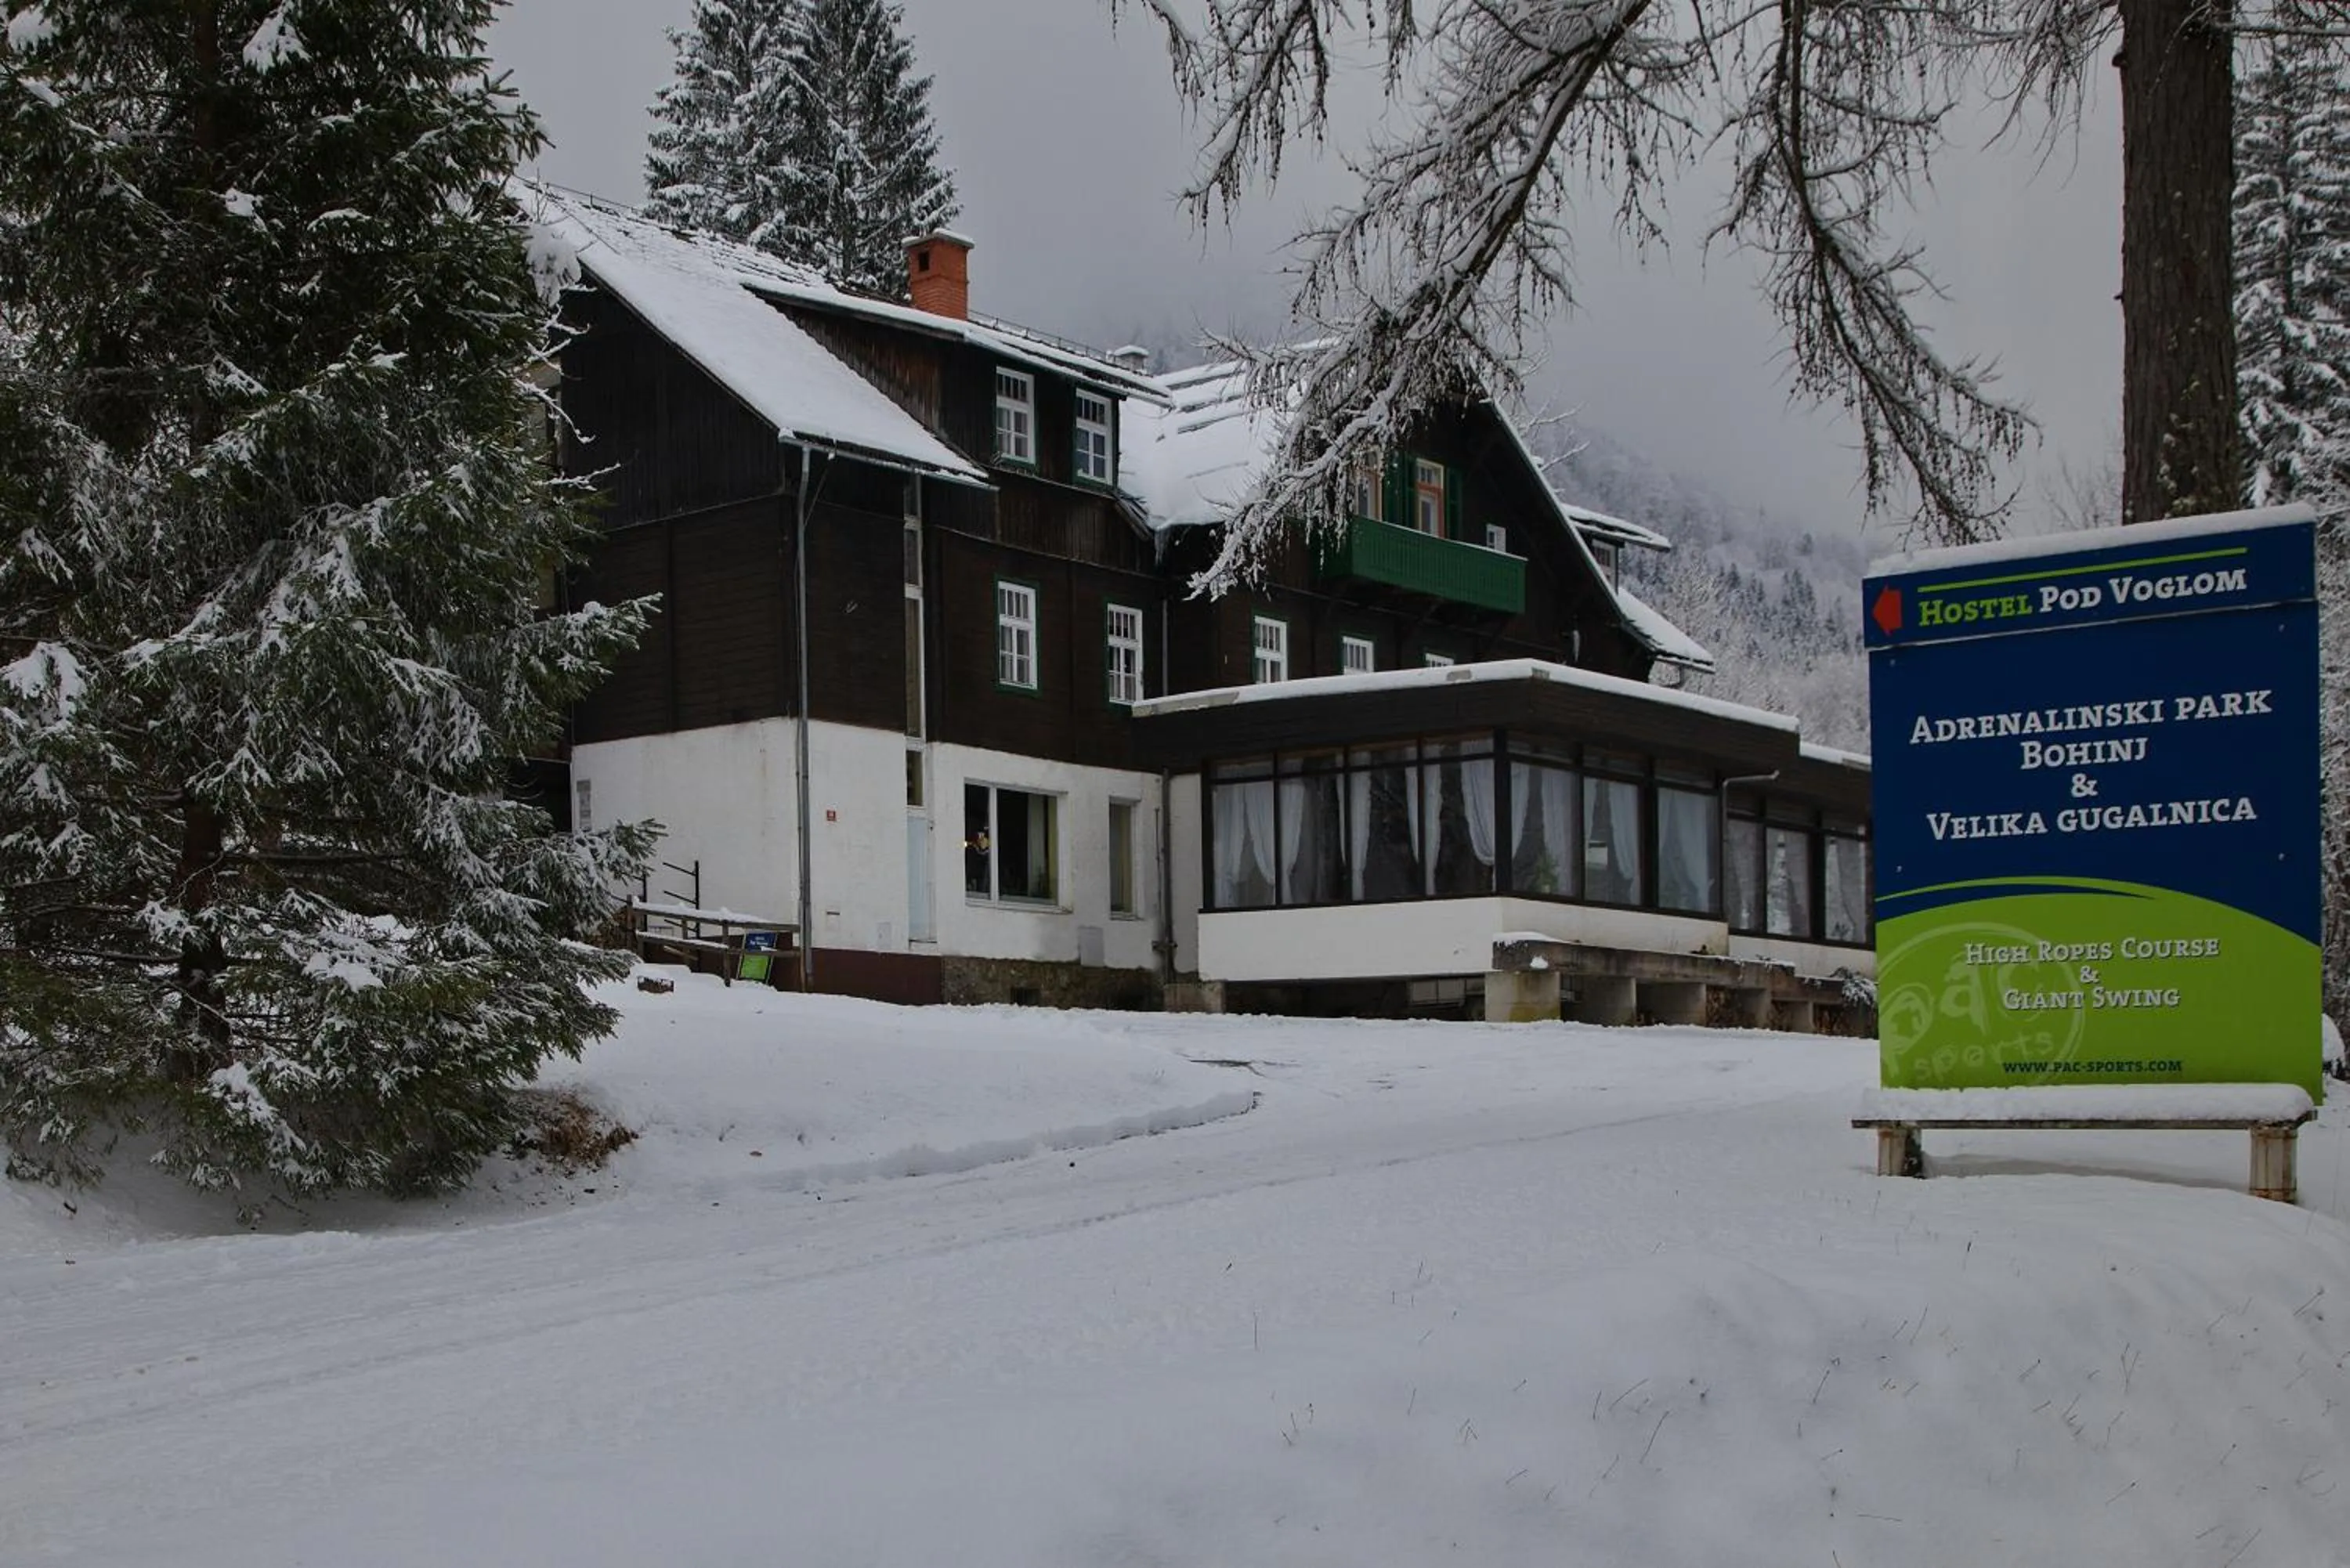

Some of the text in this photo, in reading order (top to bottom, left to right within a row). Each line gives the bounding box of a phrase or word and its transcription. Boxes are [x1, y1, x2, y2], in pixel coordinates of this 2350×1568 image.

[1919, 568, 2247, 626] HOSTEL POD VOGLOM
[1909, 689, 2272, 744] ADRENALINSKI PARK
[2020, 737, 2148, 770] BOHINJ
[2070, 773, 2098, 798] &
[1926, 797, 2257, 840] VELIKA GUGALNICA
[1965, 937, 2220, 965] HIGH ROPES COURSE
[2079, 965, 2099, 984] &
[2003, 985, 2181, 1011] GIANT SWING
[2002, 1060, 2182, 1074] WWW.PAC-SPORTS.COM
